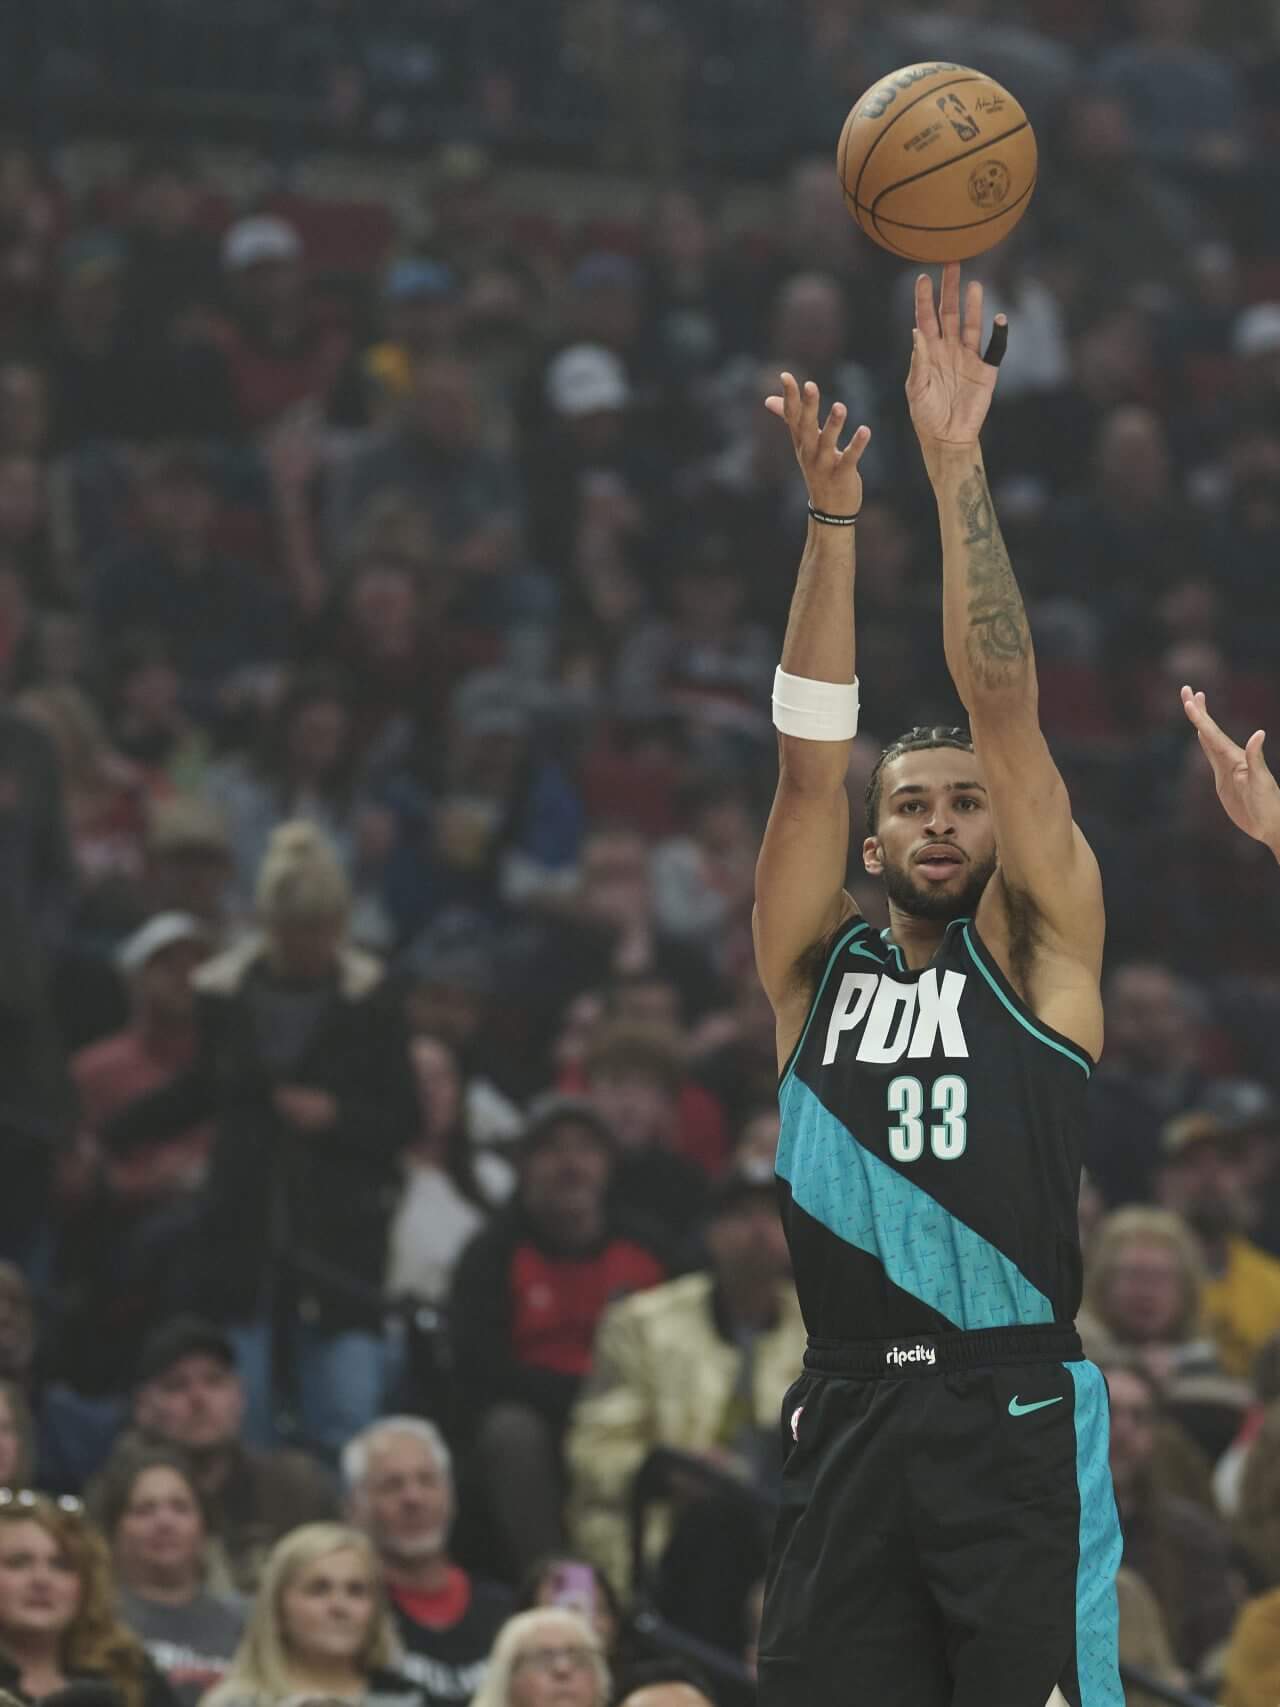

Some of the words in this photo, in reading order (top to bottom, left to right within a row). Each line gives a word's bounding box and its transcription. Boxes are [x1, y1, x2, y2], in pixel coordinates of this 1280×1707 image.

[822, 967, 969, 1066] PDX
[887, 1074, 968, 1162] 33
[886, 1344, 936, 1368] ripcity
